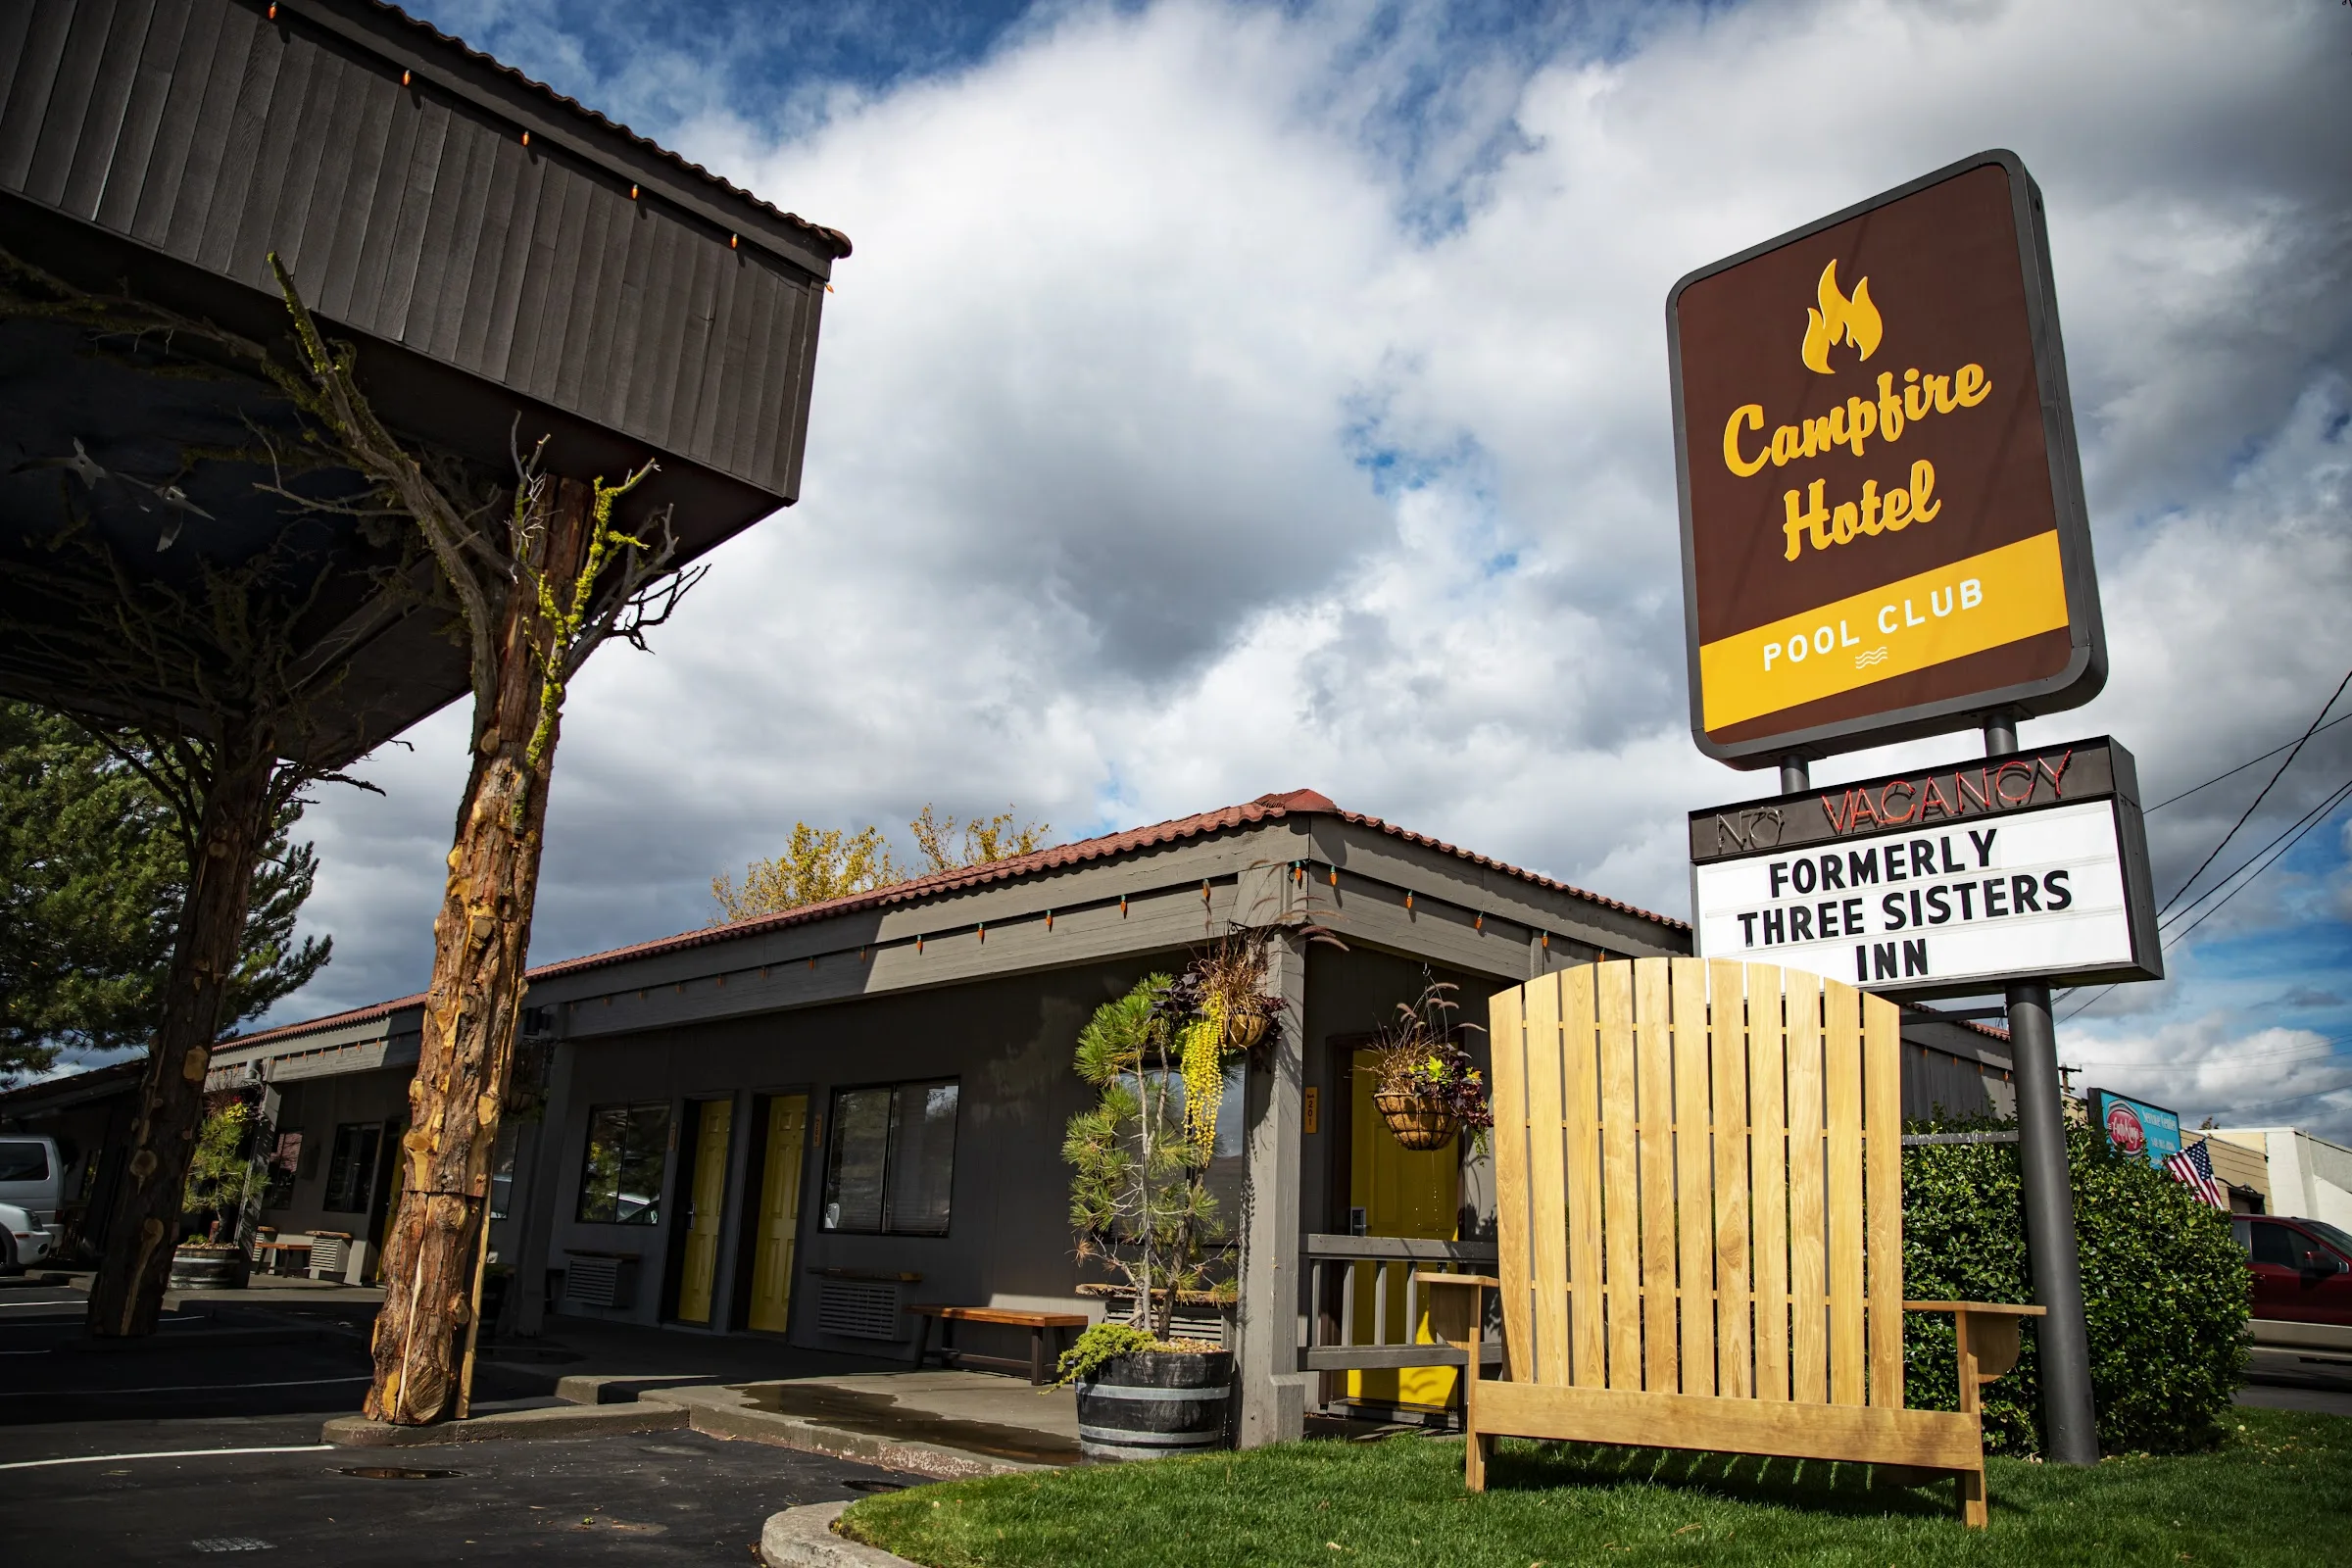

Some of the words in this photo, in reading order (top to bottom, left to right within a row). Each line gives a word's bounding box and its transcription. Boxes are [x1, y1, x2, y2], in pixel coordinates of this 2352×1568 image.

[1723, 363, 1992, 477] Campfire
[1783, 459, 1941, 563] Hotel
[1763, 619, 1860, 671] POOL
[1878, 578, 1984, 635] CLUB
[1715, 806, 1784, 855] NO
[1821, 748, 2073, 831] VACANCY
[1737, 897, 1865, 948] THREE
[1882, 869, 2073, 932] SISTERS
[1769, 827, 1998, 899] FORMERLY
[1855, 937, 1930, 982] INN
